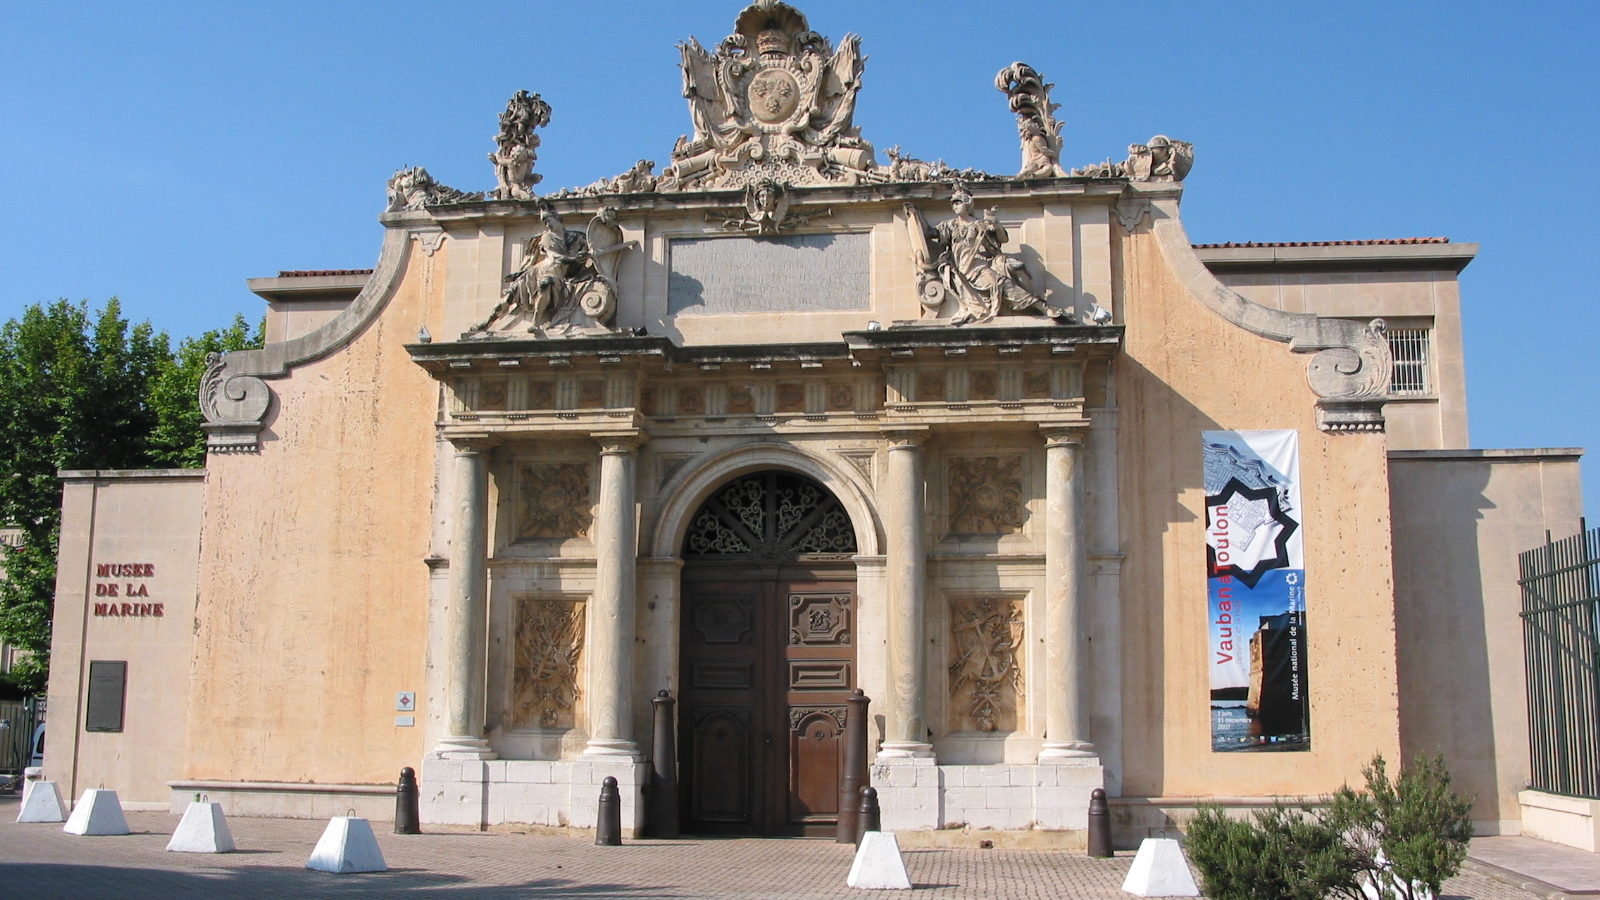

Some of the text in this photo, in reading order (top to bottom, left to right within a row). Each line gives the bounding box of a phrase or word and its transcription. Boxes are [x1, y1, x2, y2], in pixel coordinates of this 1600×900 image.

[1213, 505, 1230, 574] Toulon
[96, 563, 155, 578] MUSEE
[95, 583, 149, 597] DE LA
[1288, 586, 1296, 614] Marine
[94, 602, 164, 617] MARINE
[1216, 587, 1232, 664] Vauban
[1289, 627, 1297, 637] de
[1290, 639, 1298, 671] national
[1291, 674, 1299, 700] Musée
